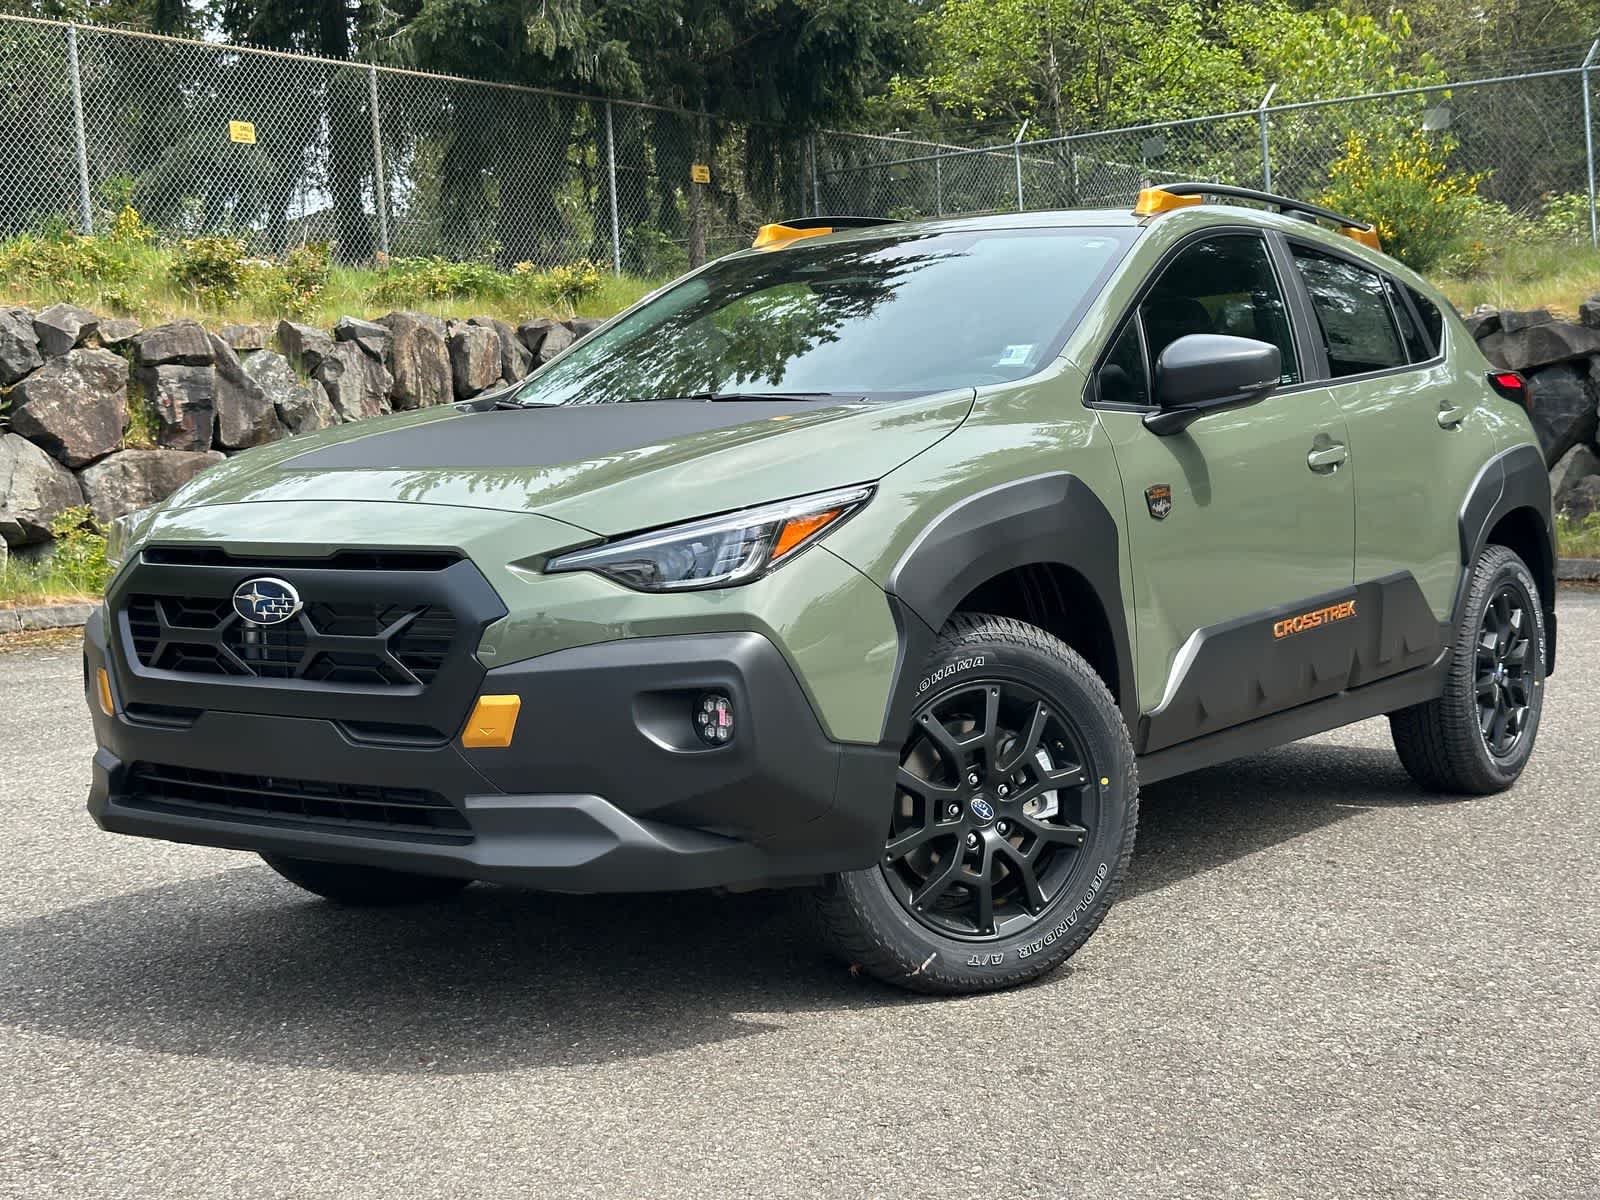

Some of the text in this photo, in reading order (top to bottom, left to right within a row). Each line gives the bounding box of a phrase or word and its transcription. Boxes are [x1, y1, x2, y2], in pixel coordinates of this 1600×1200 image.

[1273, 600, 1357, 638] CROSSTREK
[967, 863, 1108, 966] GEOLANDAR A/T
